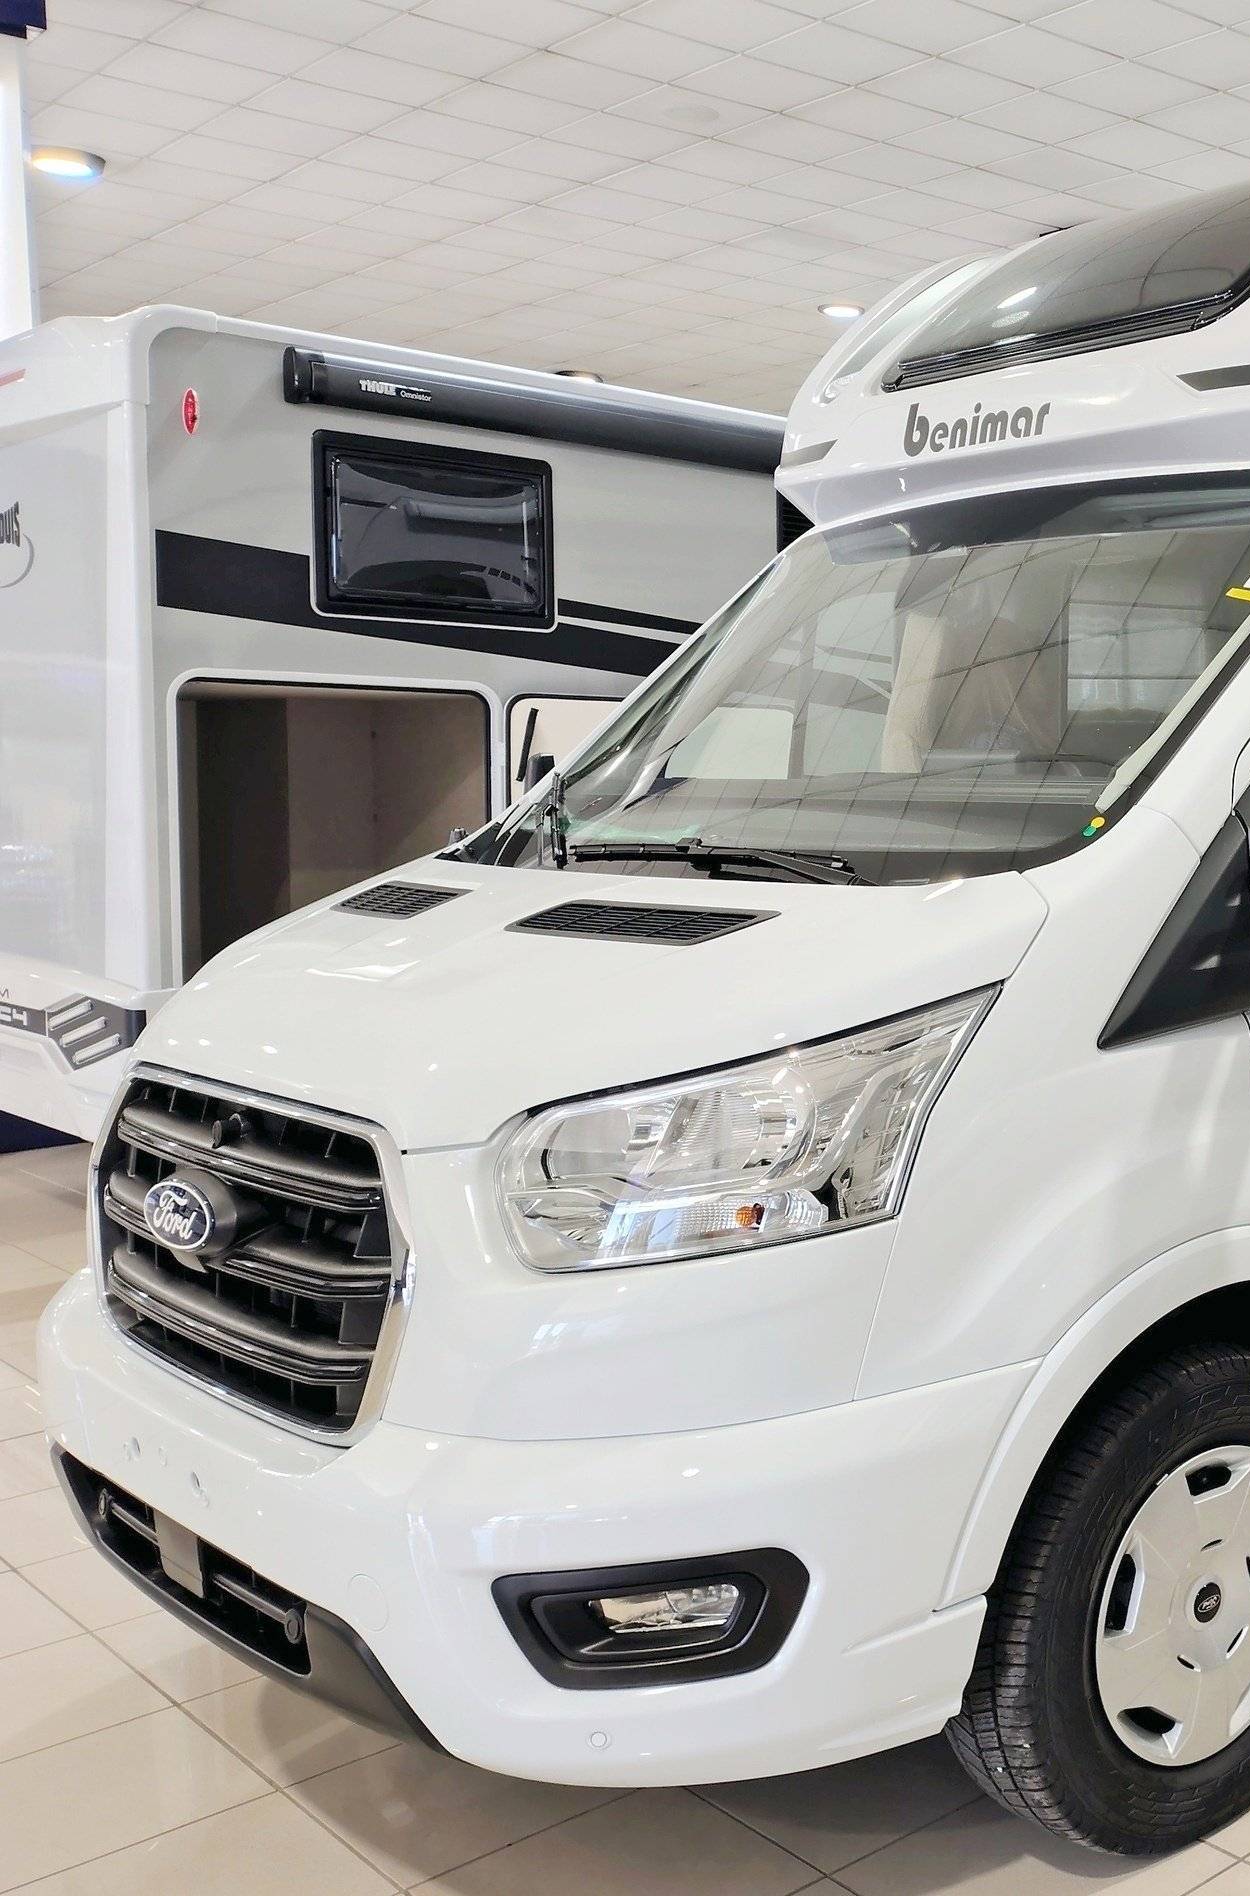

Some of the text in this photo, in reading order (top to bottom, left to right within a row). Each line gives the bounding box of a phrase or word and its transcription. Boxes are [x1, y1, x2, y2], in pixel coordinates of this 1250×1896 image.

[359, 380, 397, 396] THULE
[903, 402, 1051, 457] benimar
[153, 1190, 194, 1240] Ford
